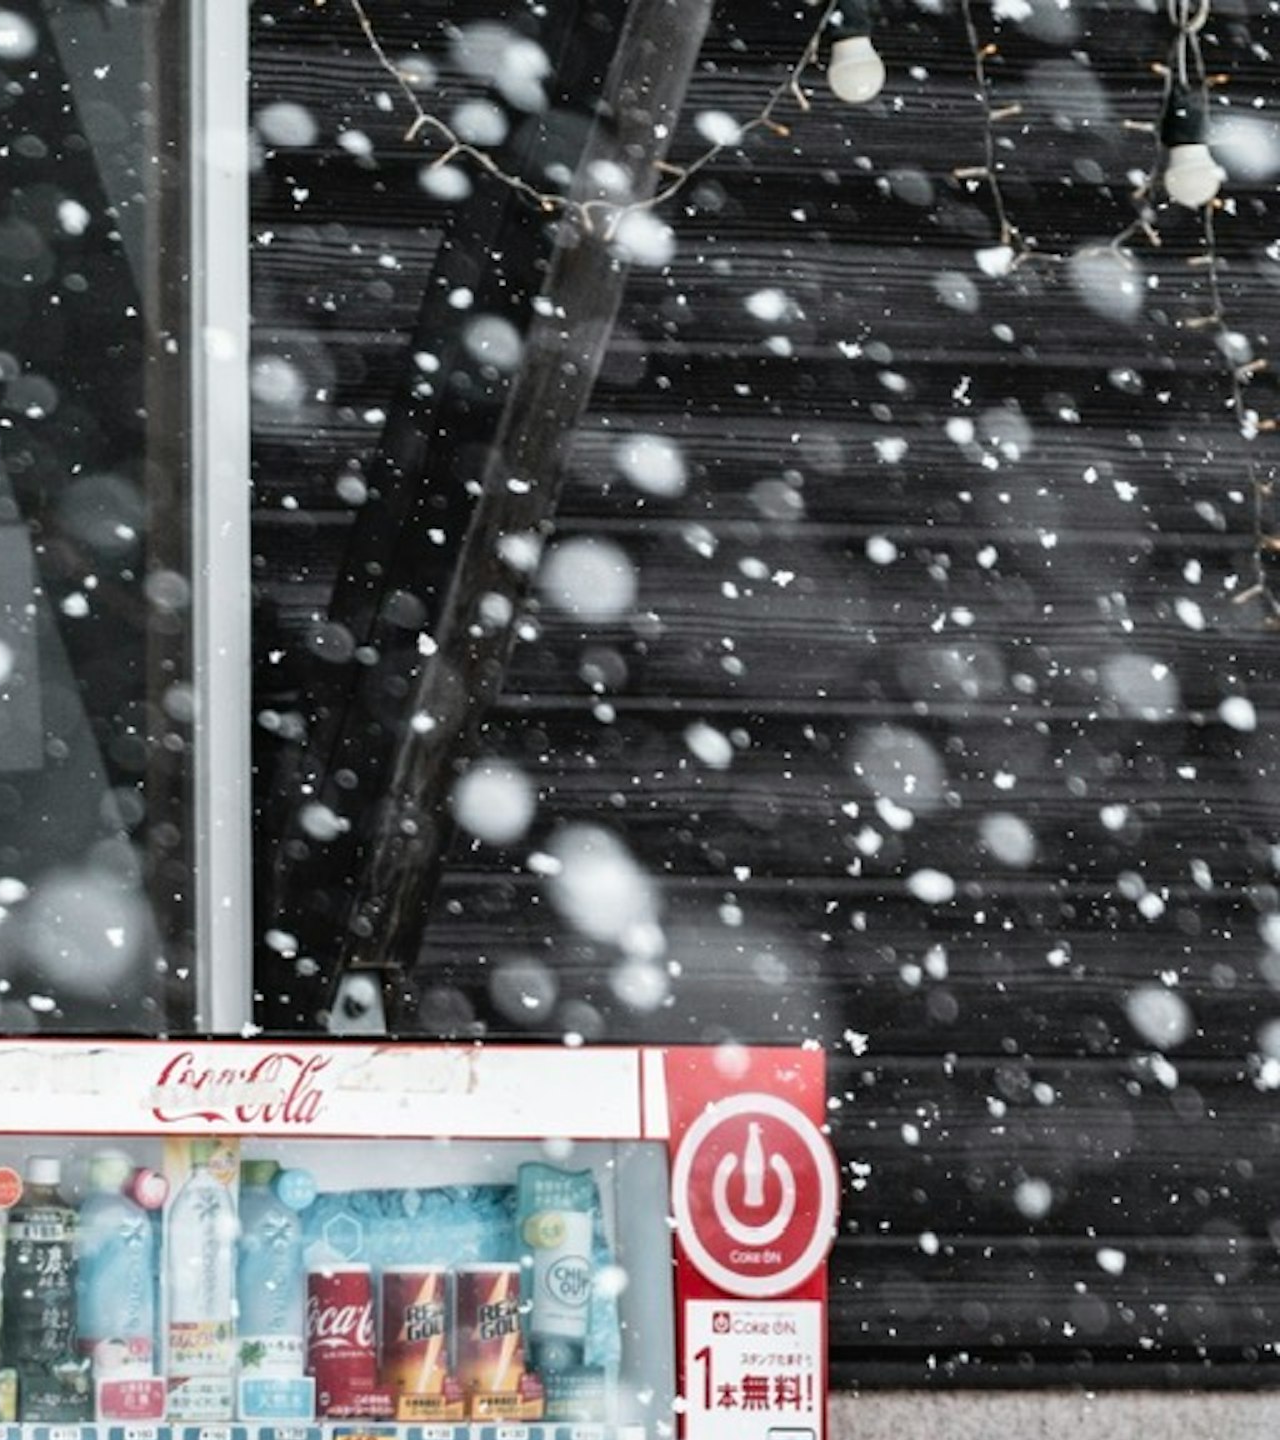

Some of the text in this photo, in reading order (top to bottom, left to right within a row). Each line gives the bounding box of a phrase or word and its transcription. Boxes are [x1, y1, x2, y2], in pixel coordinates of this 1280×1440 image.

[729, 1251, 760, 1264] Coke
[554, 1266, 582, 1281] CHIL
[733, 1319, 796, 1335] Coke ON
[693, 1345, 813, 1412] 1本無料!
